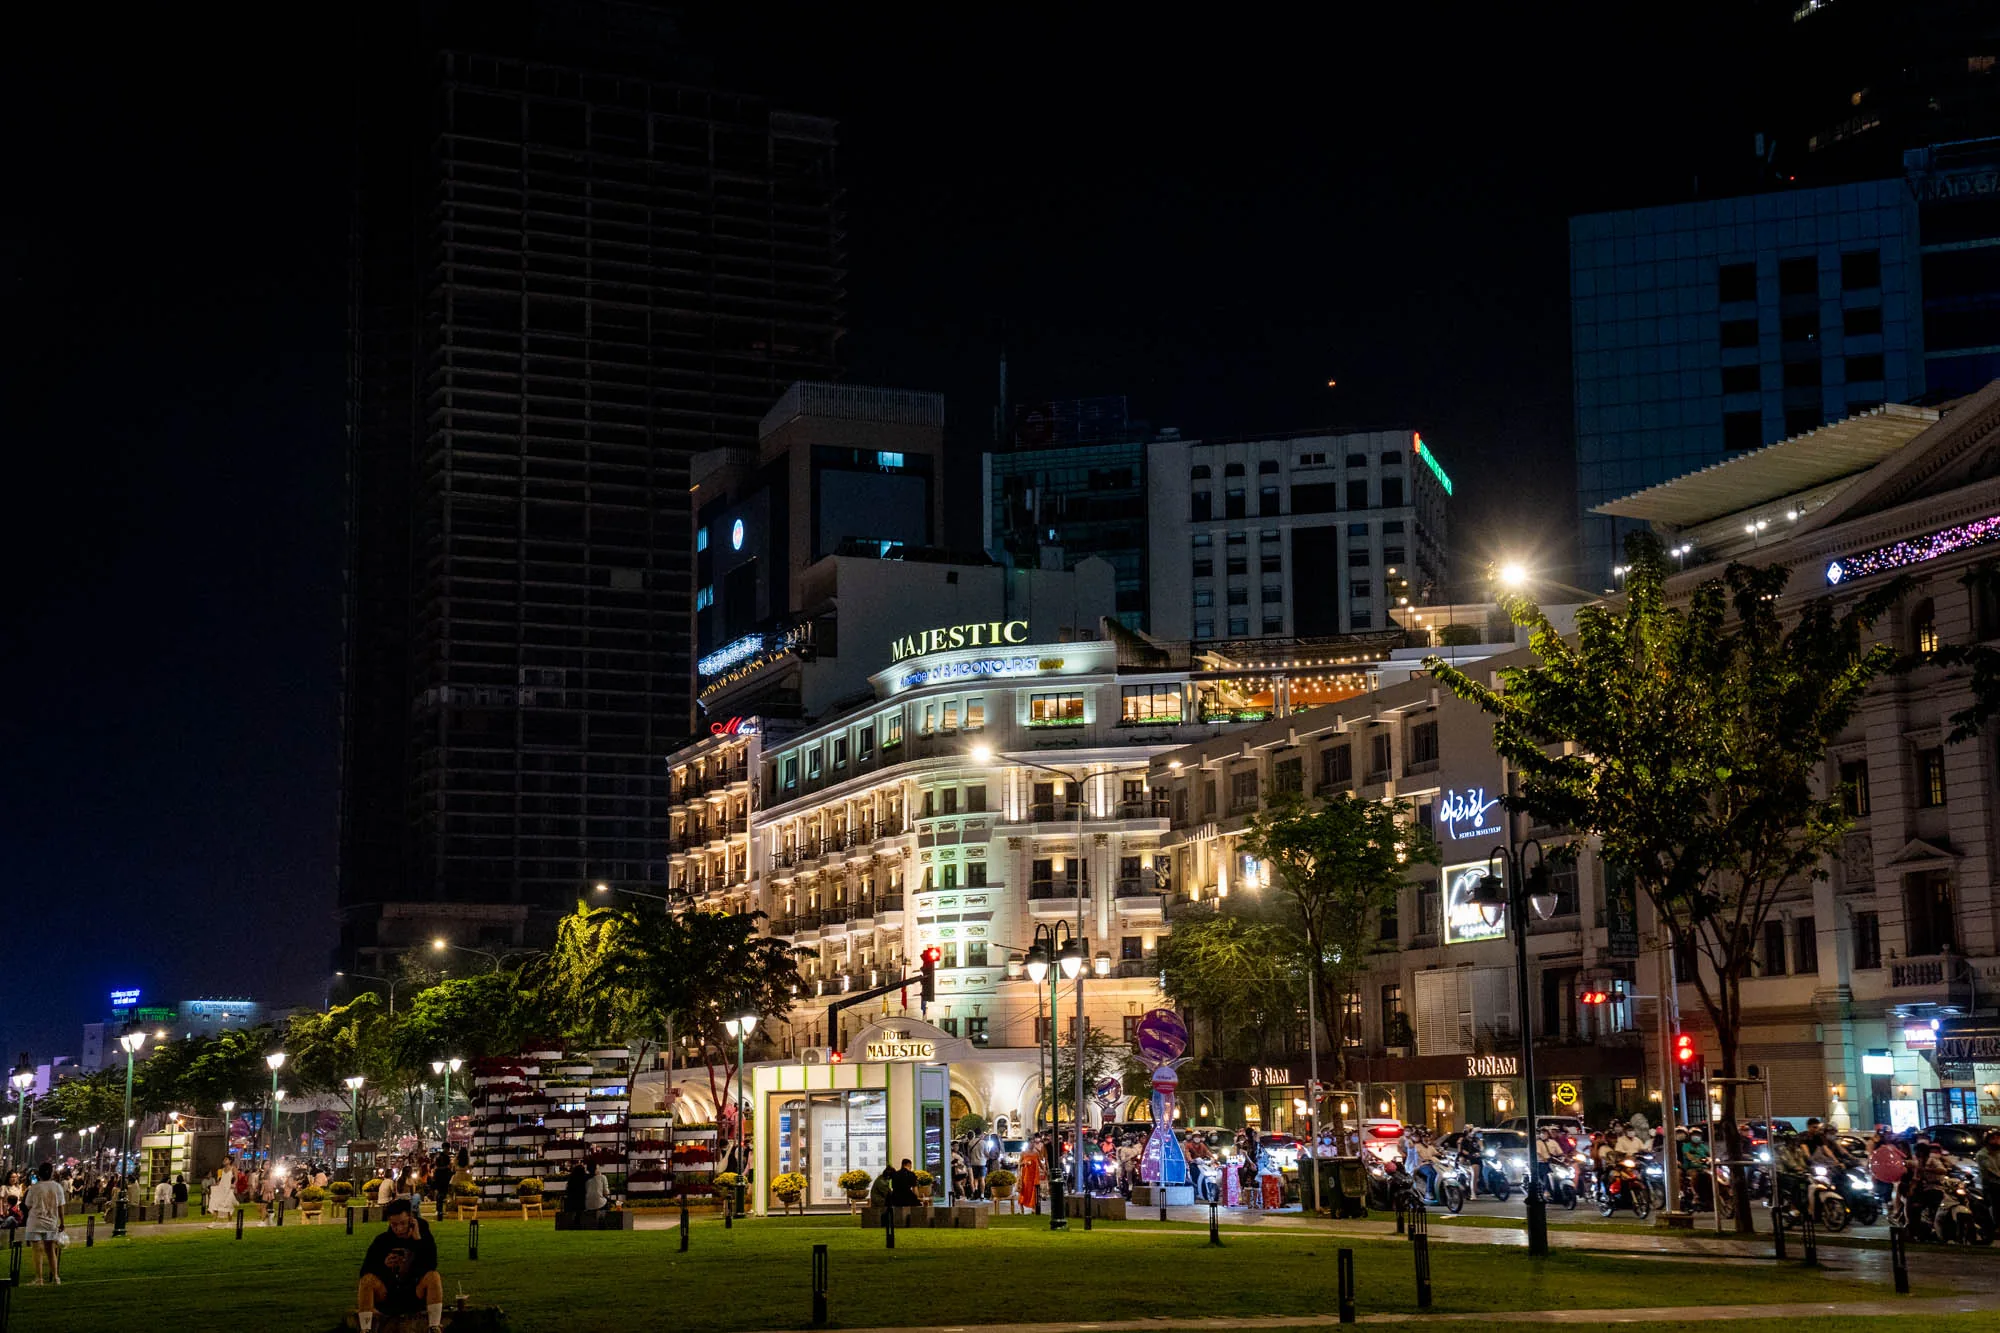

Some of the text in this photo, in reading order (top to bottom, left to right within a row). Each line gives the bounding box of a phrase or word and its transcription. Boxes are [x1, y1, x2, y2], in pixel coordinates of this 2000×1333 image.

[892, 620, 1028, 662] MAJESTIC
[943, 656, 1039, 678] SAIGONTOURIST
[882, 1030, 913, 1041] HOTEL
[867, 1043, 932, 1058] MAJESTIC
